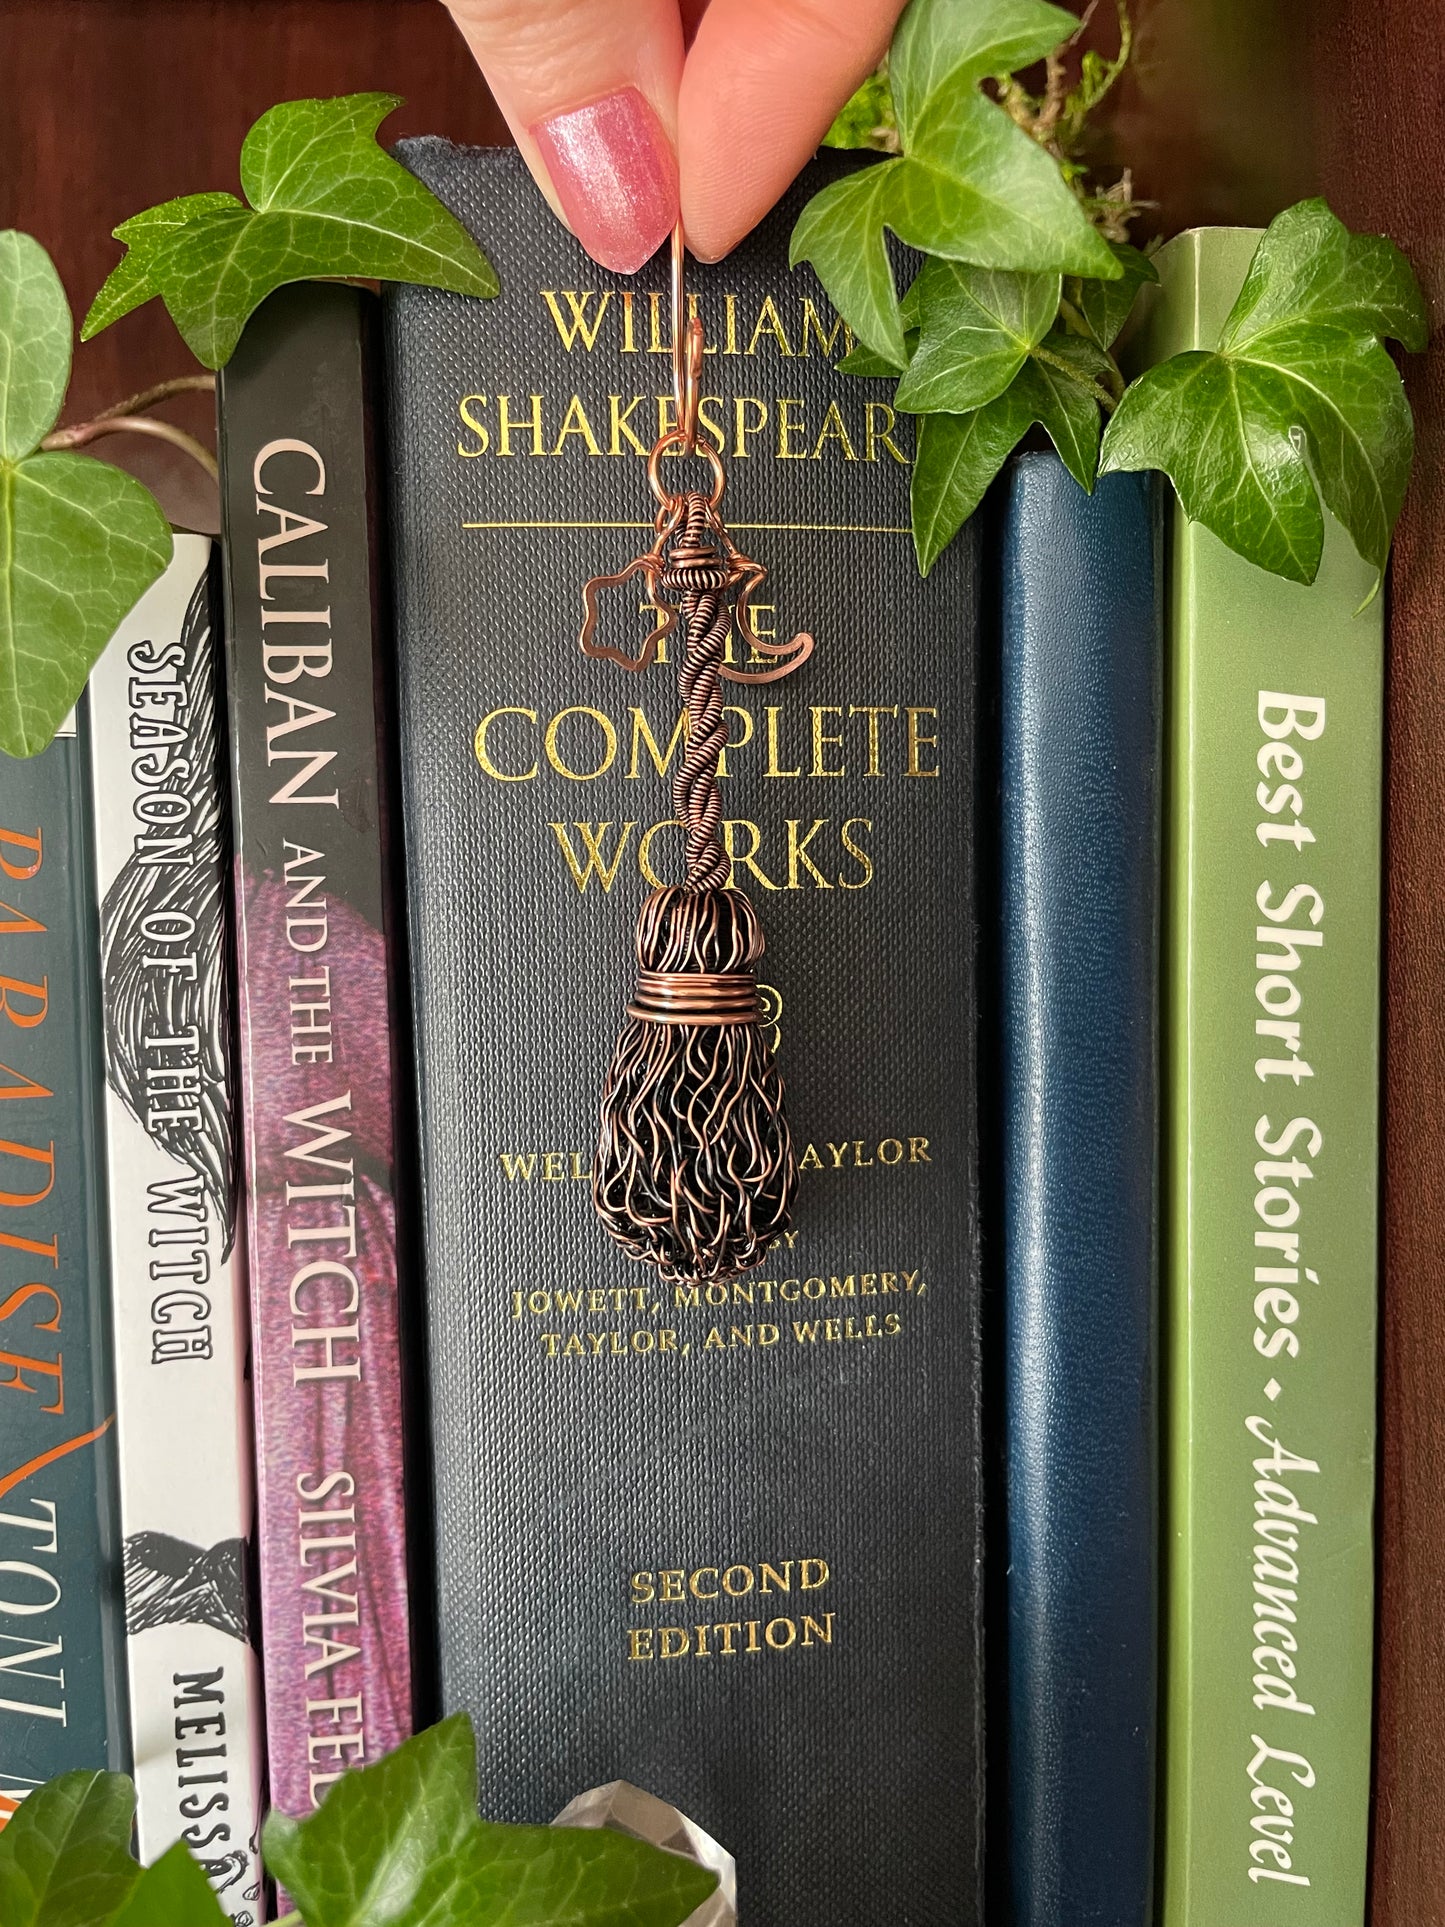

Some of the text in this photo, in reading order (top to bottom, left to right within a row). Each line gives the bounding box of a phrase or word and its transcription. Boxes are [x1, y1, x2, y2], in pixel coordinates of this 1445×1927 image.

[457, 393, 915, 465] SHAKESPEAR
[474, 704, 941, 780] COMPLETE
[547, 817, 874, 894] WORKS
[253, 437, 362, 1388] CALIBAN AND THE WITCH
[127, 639, 214, 1365] SEASON OF THE WITCH
[499, 1136, 933, 1182] WEL AYLOR
[511, 1269, 929, 1319] JOWETT, MONTGOMERY,
[1244, 690, 1326, 1887] Best Short Stories Advanced Level
[540, 1312, 903, 1357] TAYLOR, AND WELLS
[296, 1470, 362, 1680] SILVIA
[630, 1557, 831, 1605] SECOND
[626, 1611, 837, 1661] EDITION
[173, 1665, 232, 1878] MELISS
